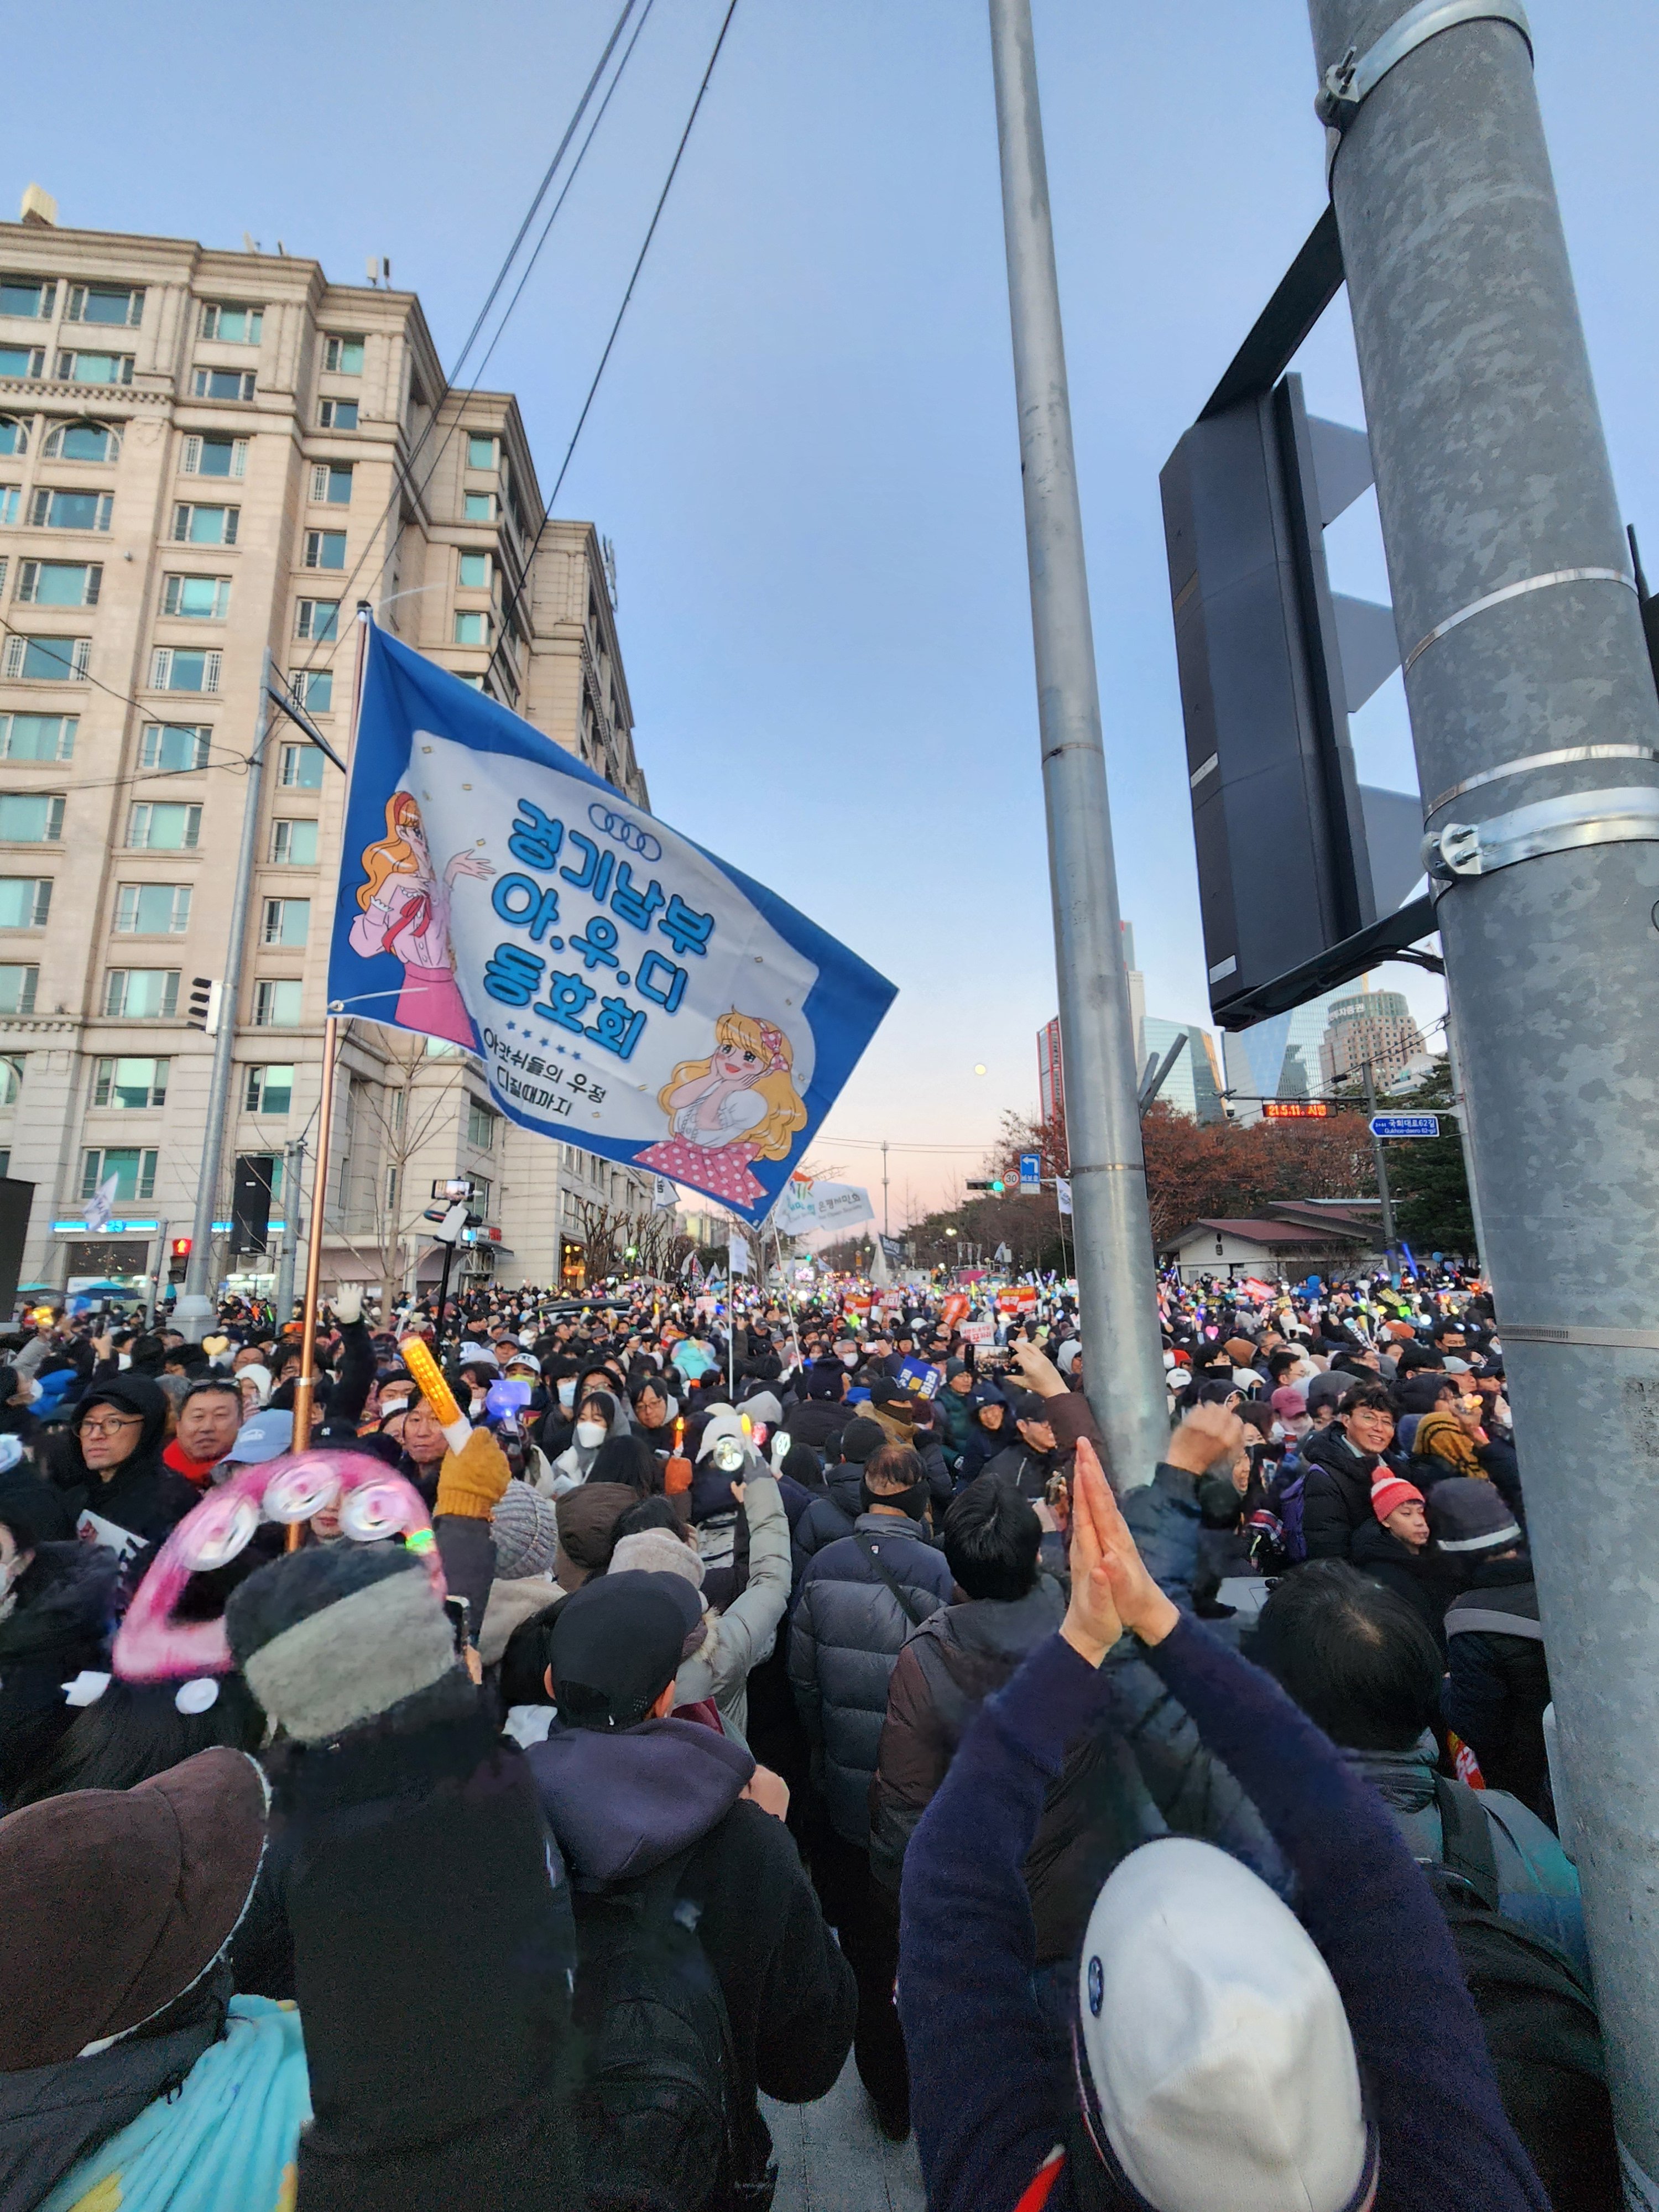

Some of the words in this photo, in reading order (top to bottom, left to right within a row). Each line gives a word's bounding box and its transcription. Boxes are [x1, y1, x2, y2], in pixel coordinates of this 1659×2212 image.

[508, 799, 714, 955] 경기남부
[483, 943, 647, 1060] 동호회
[566, 1073, 606, 1104] 우정
[1389, 1119, 1435, 1128] 국회대로62길
[1006, 1175, 1016, 1183] 30
